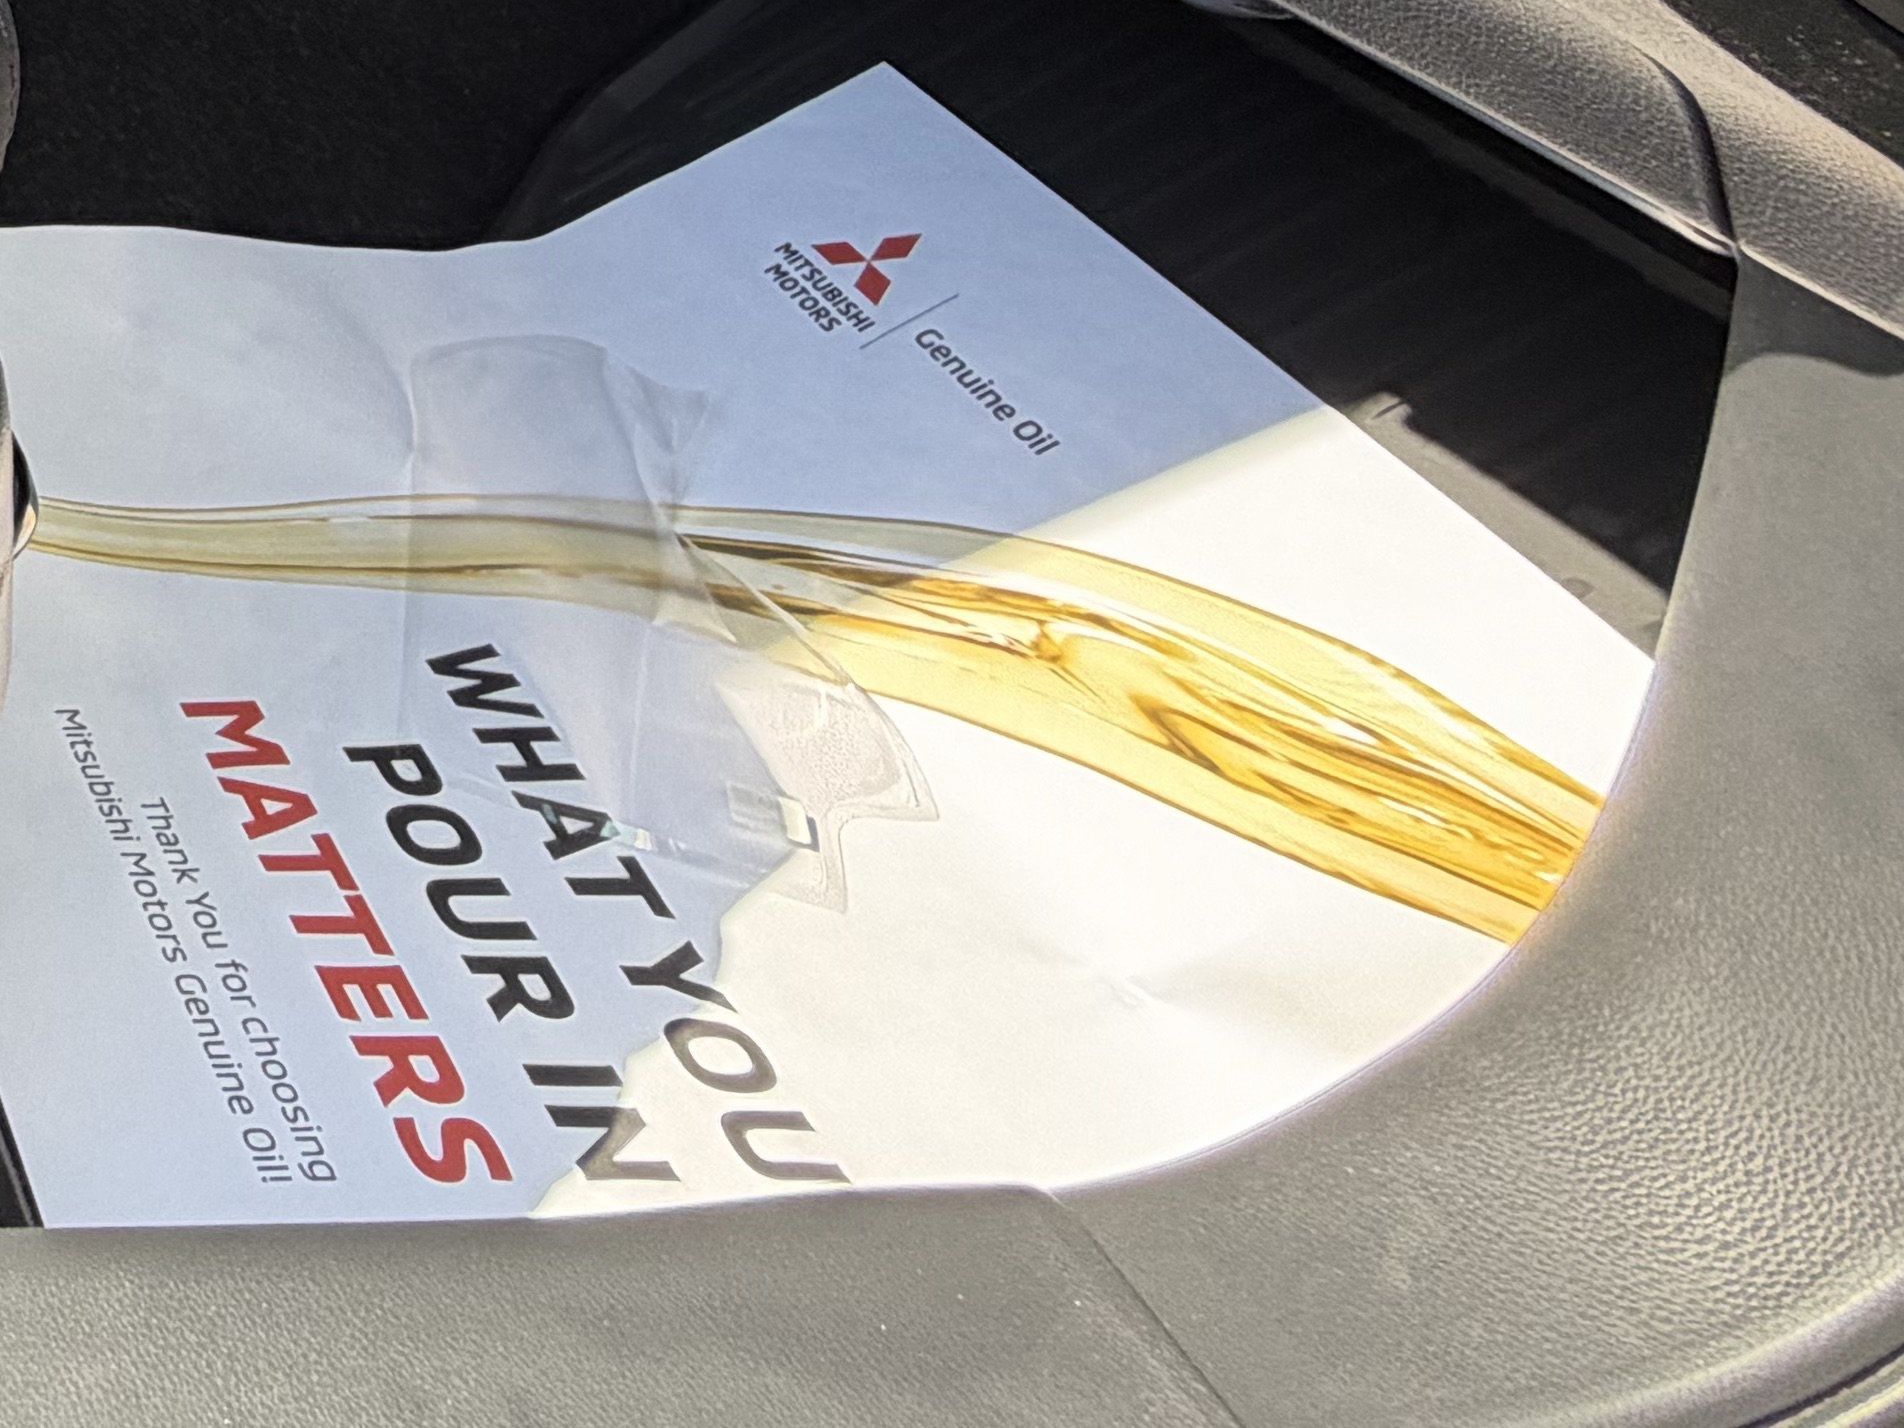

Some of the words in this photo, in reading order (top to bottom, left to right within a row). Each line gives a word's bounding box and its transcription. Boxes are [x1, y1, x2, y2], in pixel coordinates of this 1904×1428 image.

[764, 263, 843, 333] MOTORS
[774, 242, 876, 332] MITSUBISHI
[914, 328, 1018, 422] Genuine
[1012, 419, 1061, 456] Oil
[54, 709, 140, 841] Mitsubishi
[120, 852, 187, 962] Motors
[175, 974, 254, 1114] Genuine
[242, 1127, 292, 1183] Oil!
[141, 797, 200, 884] Thank
[185, 891, 228, 948] You
[215, 959, 256, 1008] for
[242, 1017, 337, 1181] choosing
[179, 700, 513, 1185] MATTERS
[342, 741, 575, 1023] POUR
[524, 1062, 681, 1182] IN
[424, 642, 676, 920] WHAT
[620, 940, 851, 1184] YOU
